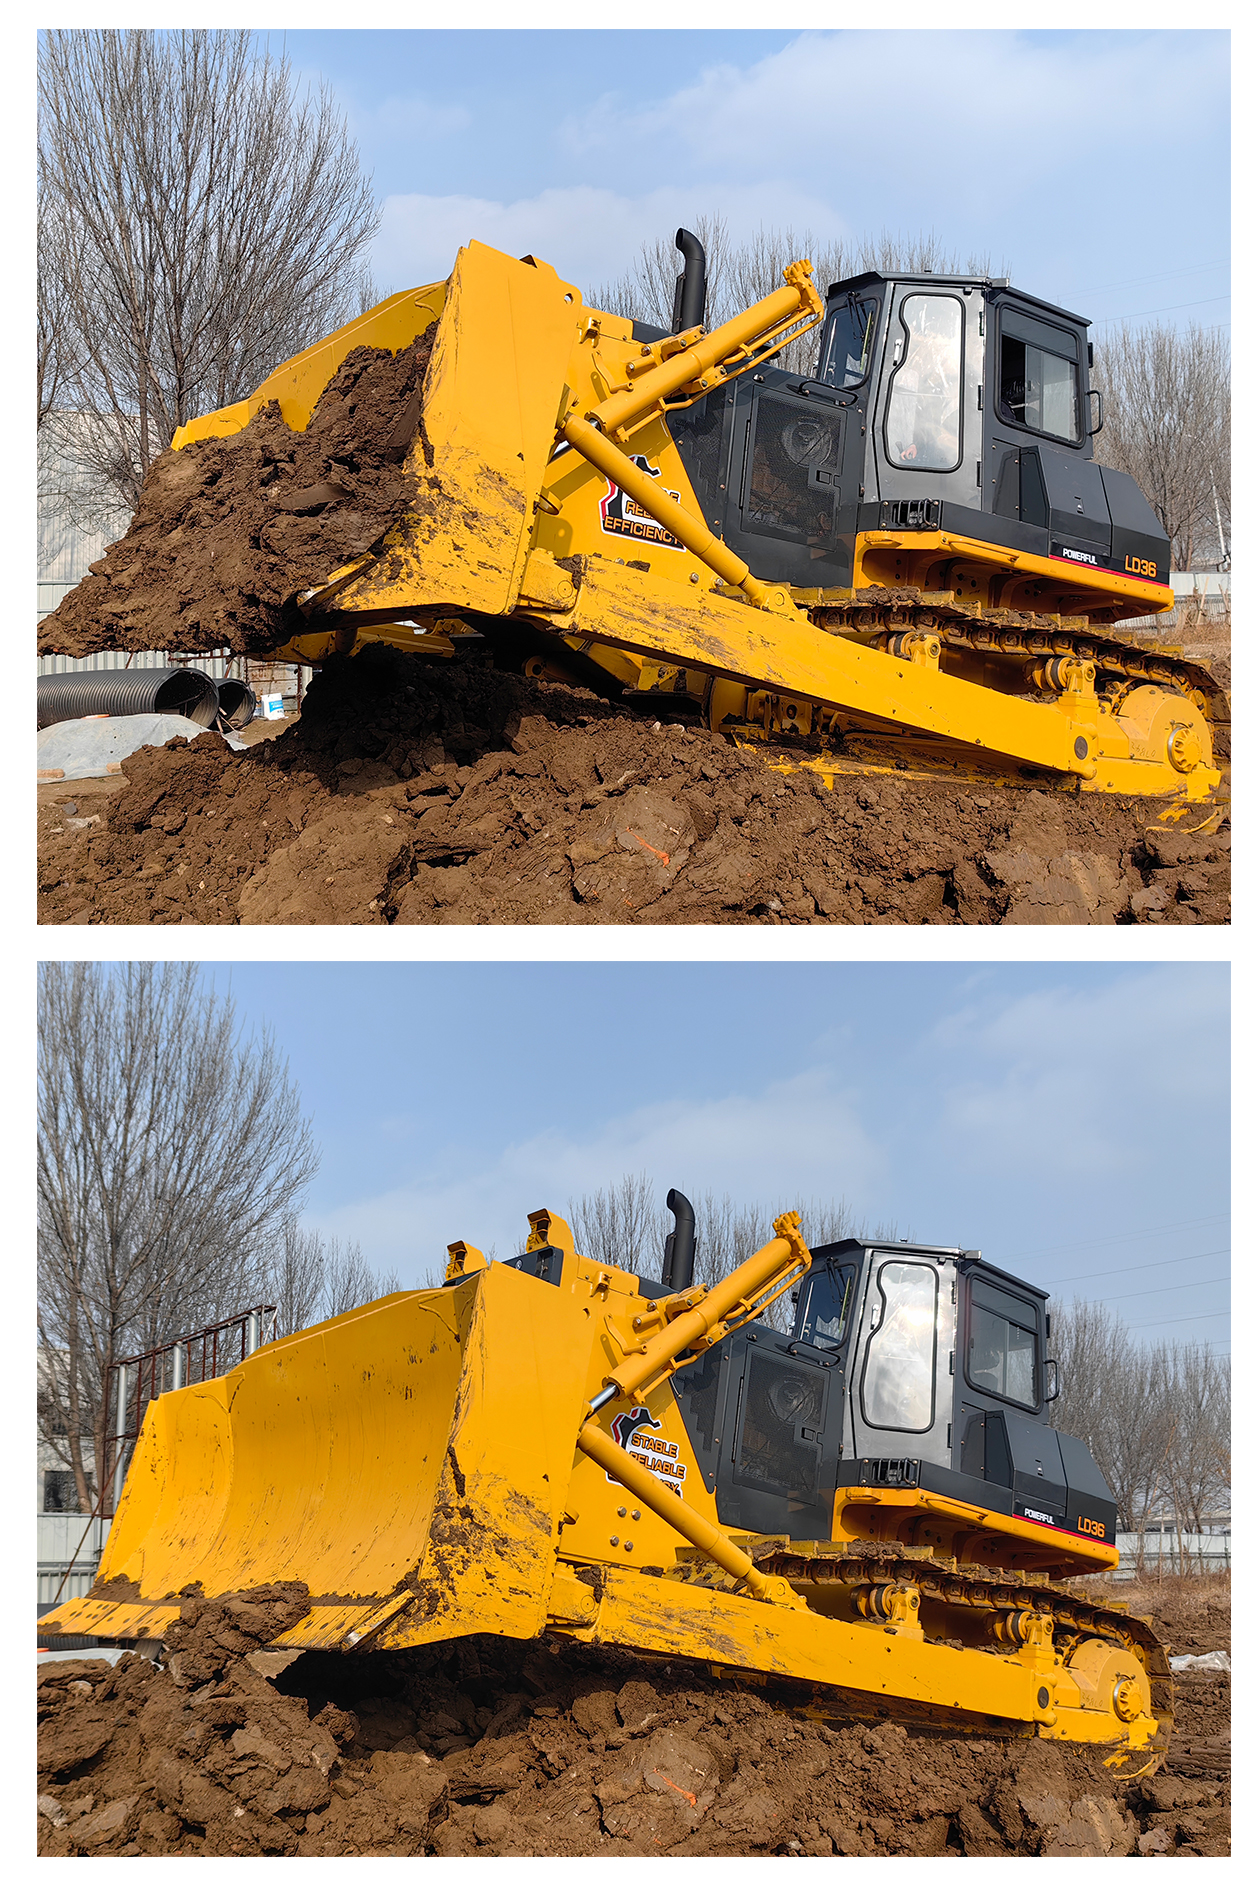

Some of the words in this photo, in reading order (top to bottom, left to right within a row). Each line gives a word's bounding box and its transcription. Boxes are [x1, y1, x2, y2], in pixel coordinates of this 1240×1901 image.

[1062, 547, 1098, 565] POWERFUL
[1125, 554, 1157, 578] LD36
[632, 1433, 678, 1458] STABLE
[1024, 1507, 1055, 1525] POWERFUL
[1077, 1516, 1106, 1538] LD36
